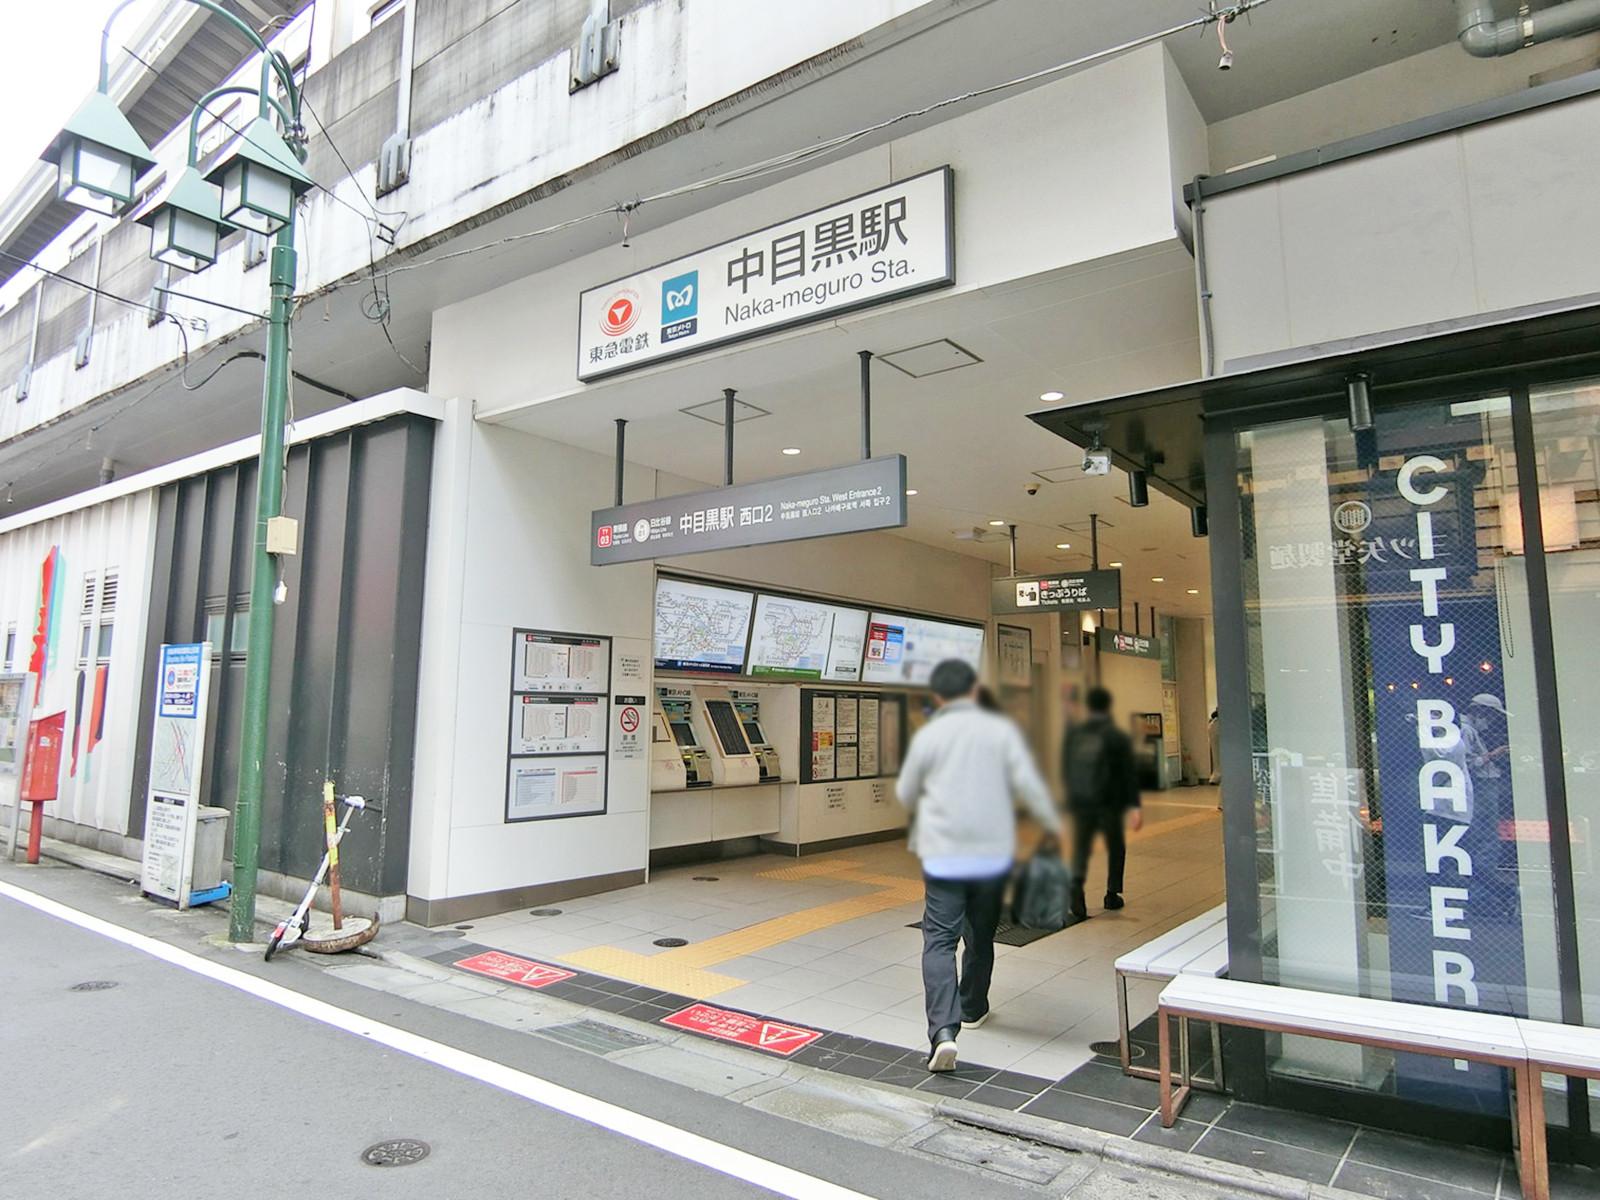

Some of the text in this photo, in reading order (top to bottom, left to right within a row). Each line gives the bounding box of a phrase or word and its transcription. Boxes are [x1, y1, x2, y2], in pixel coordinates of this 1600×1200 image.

[727, 196, 908, 294] 中目黒駅
[725, 259, 916, 325] Naka-meguro Sta.
[589, 331, 650, 364] 東急電鉄
[680, 504, 773, 535] 中目黒駅 西口2
[780, 498, 819, 510] Naka-meguro
[600, 536, 609, 545] 03
[1041, 586, 1088, 599] きっぷうりば
[1397, 455, 1480, 1072] CITY BAKER
